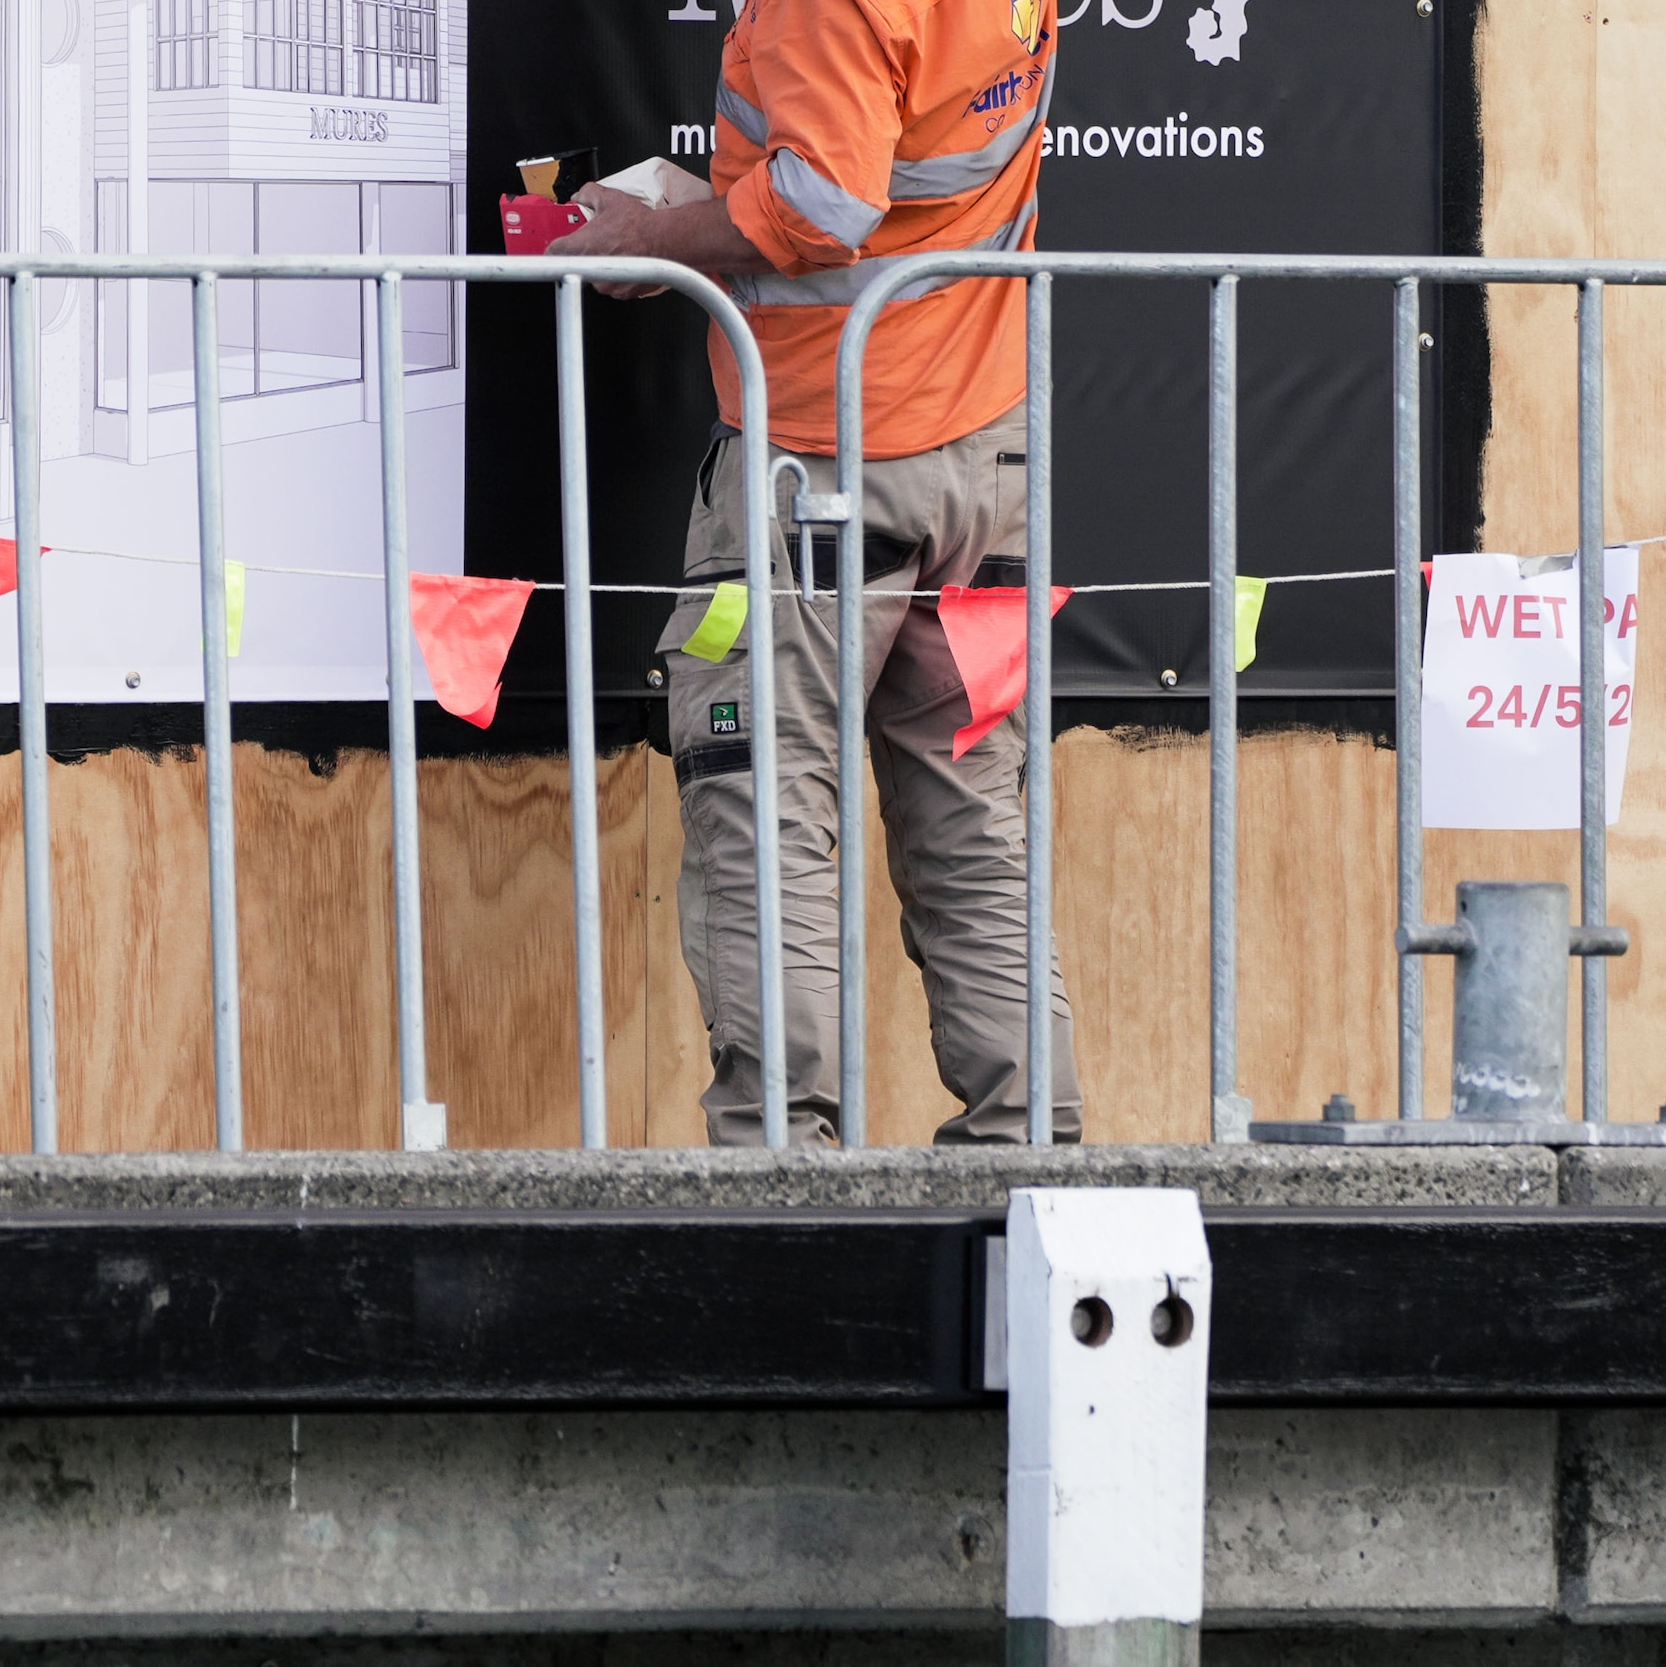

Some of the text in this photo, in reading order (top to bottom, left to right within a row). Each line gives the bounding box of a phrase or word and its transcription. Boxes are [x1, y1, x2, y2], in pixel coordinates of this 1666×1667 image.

[309, 107, 389, 142] MURES
[1041, 111, 1265, 158] enovations
[1455, 595, 1567, 639] WET
[713, 720, 736, 732] FXD
